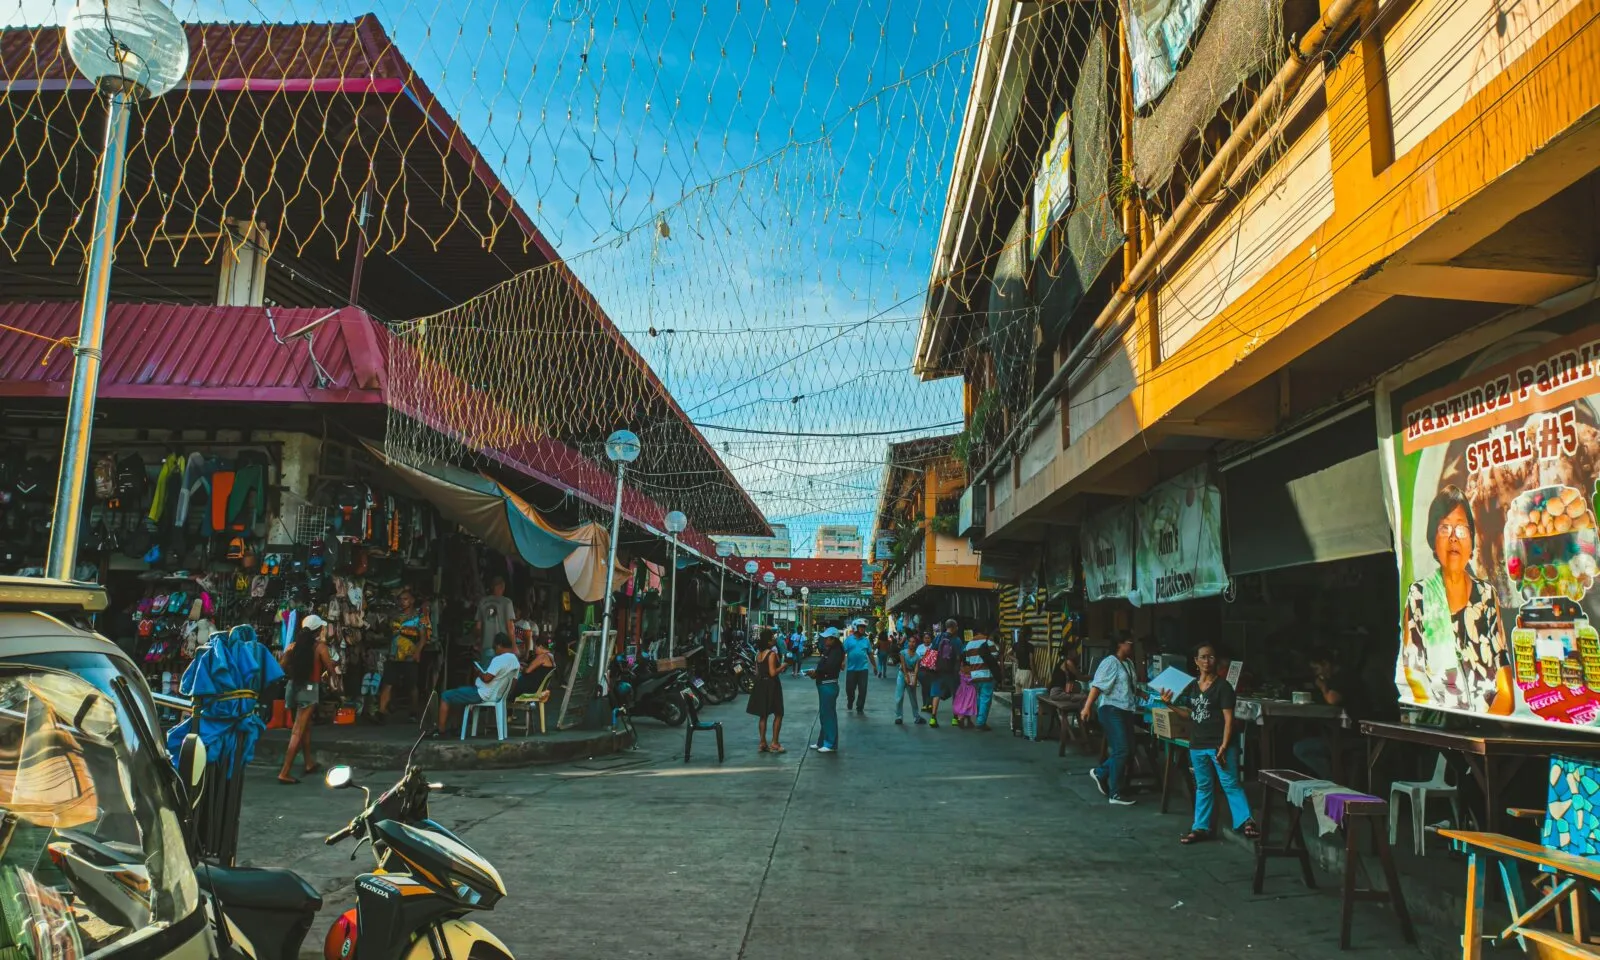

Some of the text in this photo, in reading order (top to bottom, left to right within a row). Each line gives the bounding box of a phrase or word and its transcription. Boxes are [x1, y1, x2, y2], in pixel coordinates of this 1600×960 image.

[1540, 411, 1577, 458] #5
[824, 597, 869, 606] PAINITAN
[359, 881, 390, 899] HONDA
